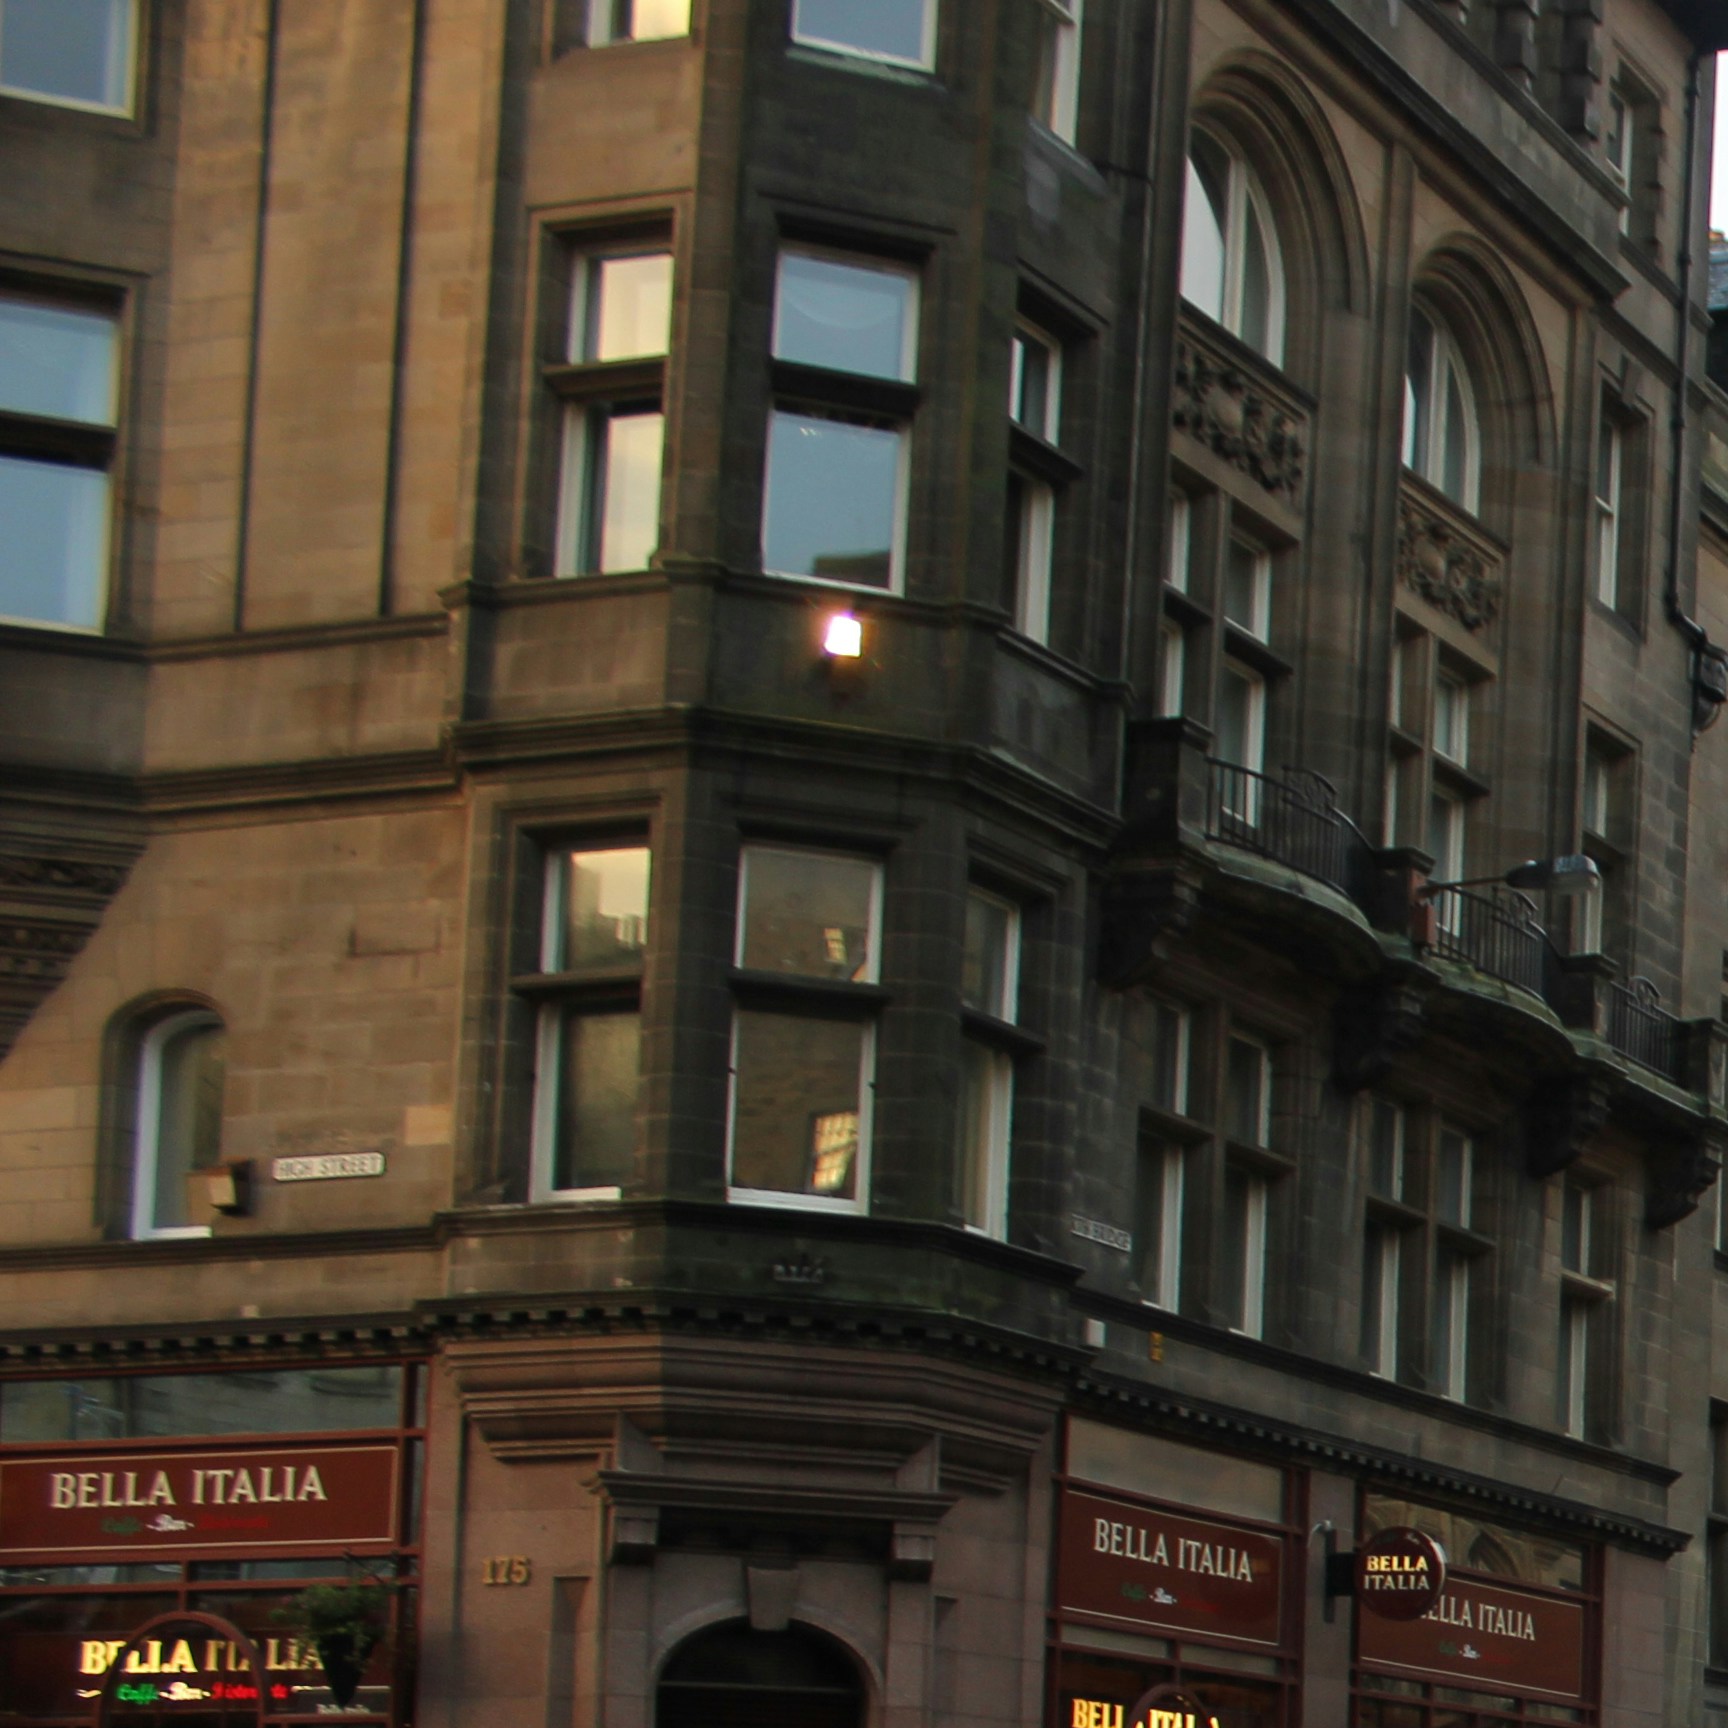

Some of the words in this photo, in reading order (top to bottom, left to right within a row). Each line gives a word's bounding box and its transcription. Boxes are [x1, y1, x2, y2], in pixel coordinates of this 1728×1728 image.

[319, 1156, 381, 1175] STREET
[51, 1470, 176, 1508] BELLA
[192, 1465, 327, 1504] ITALIA
[1094, 1518, 1169, 1567] BELLA
[1178, 1537, 1253, 1582] ITALIA
[1366, 1555, 1429, 1572] BELLA
[1363, 1575, 1430, 1590] ITALIA
[1478, 1603, 1536, 1641] ITALIA
